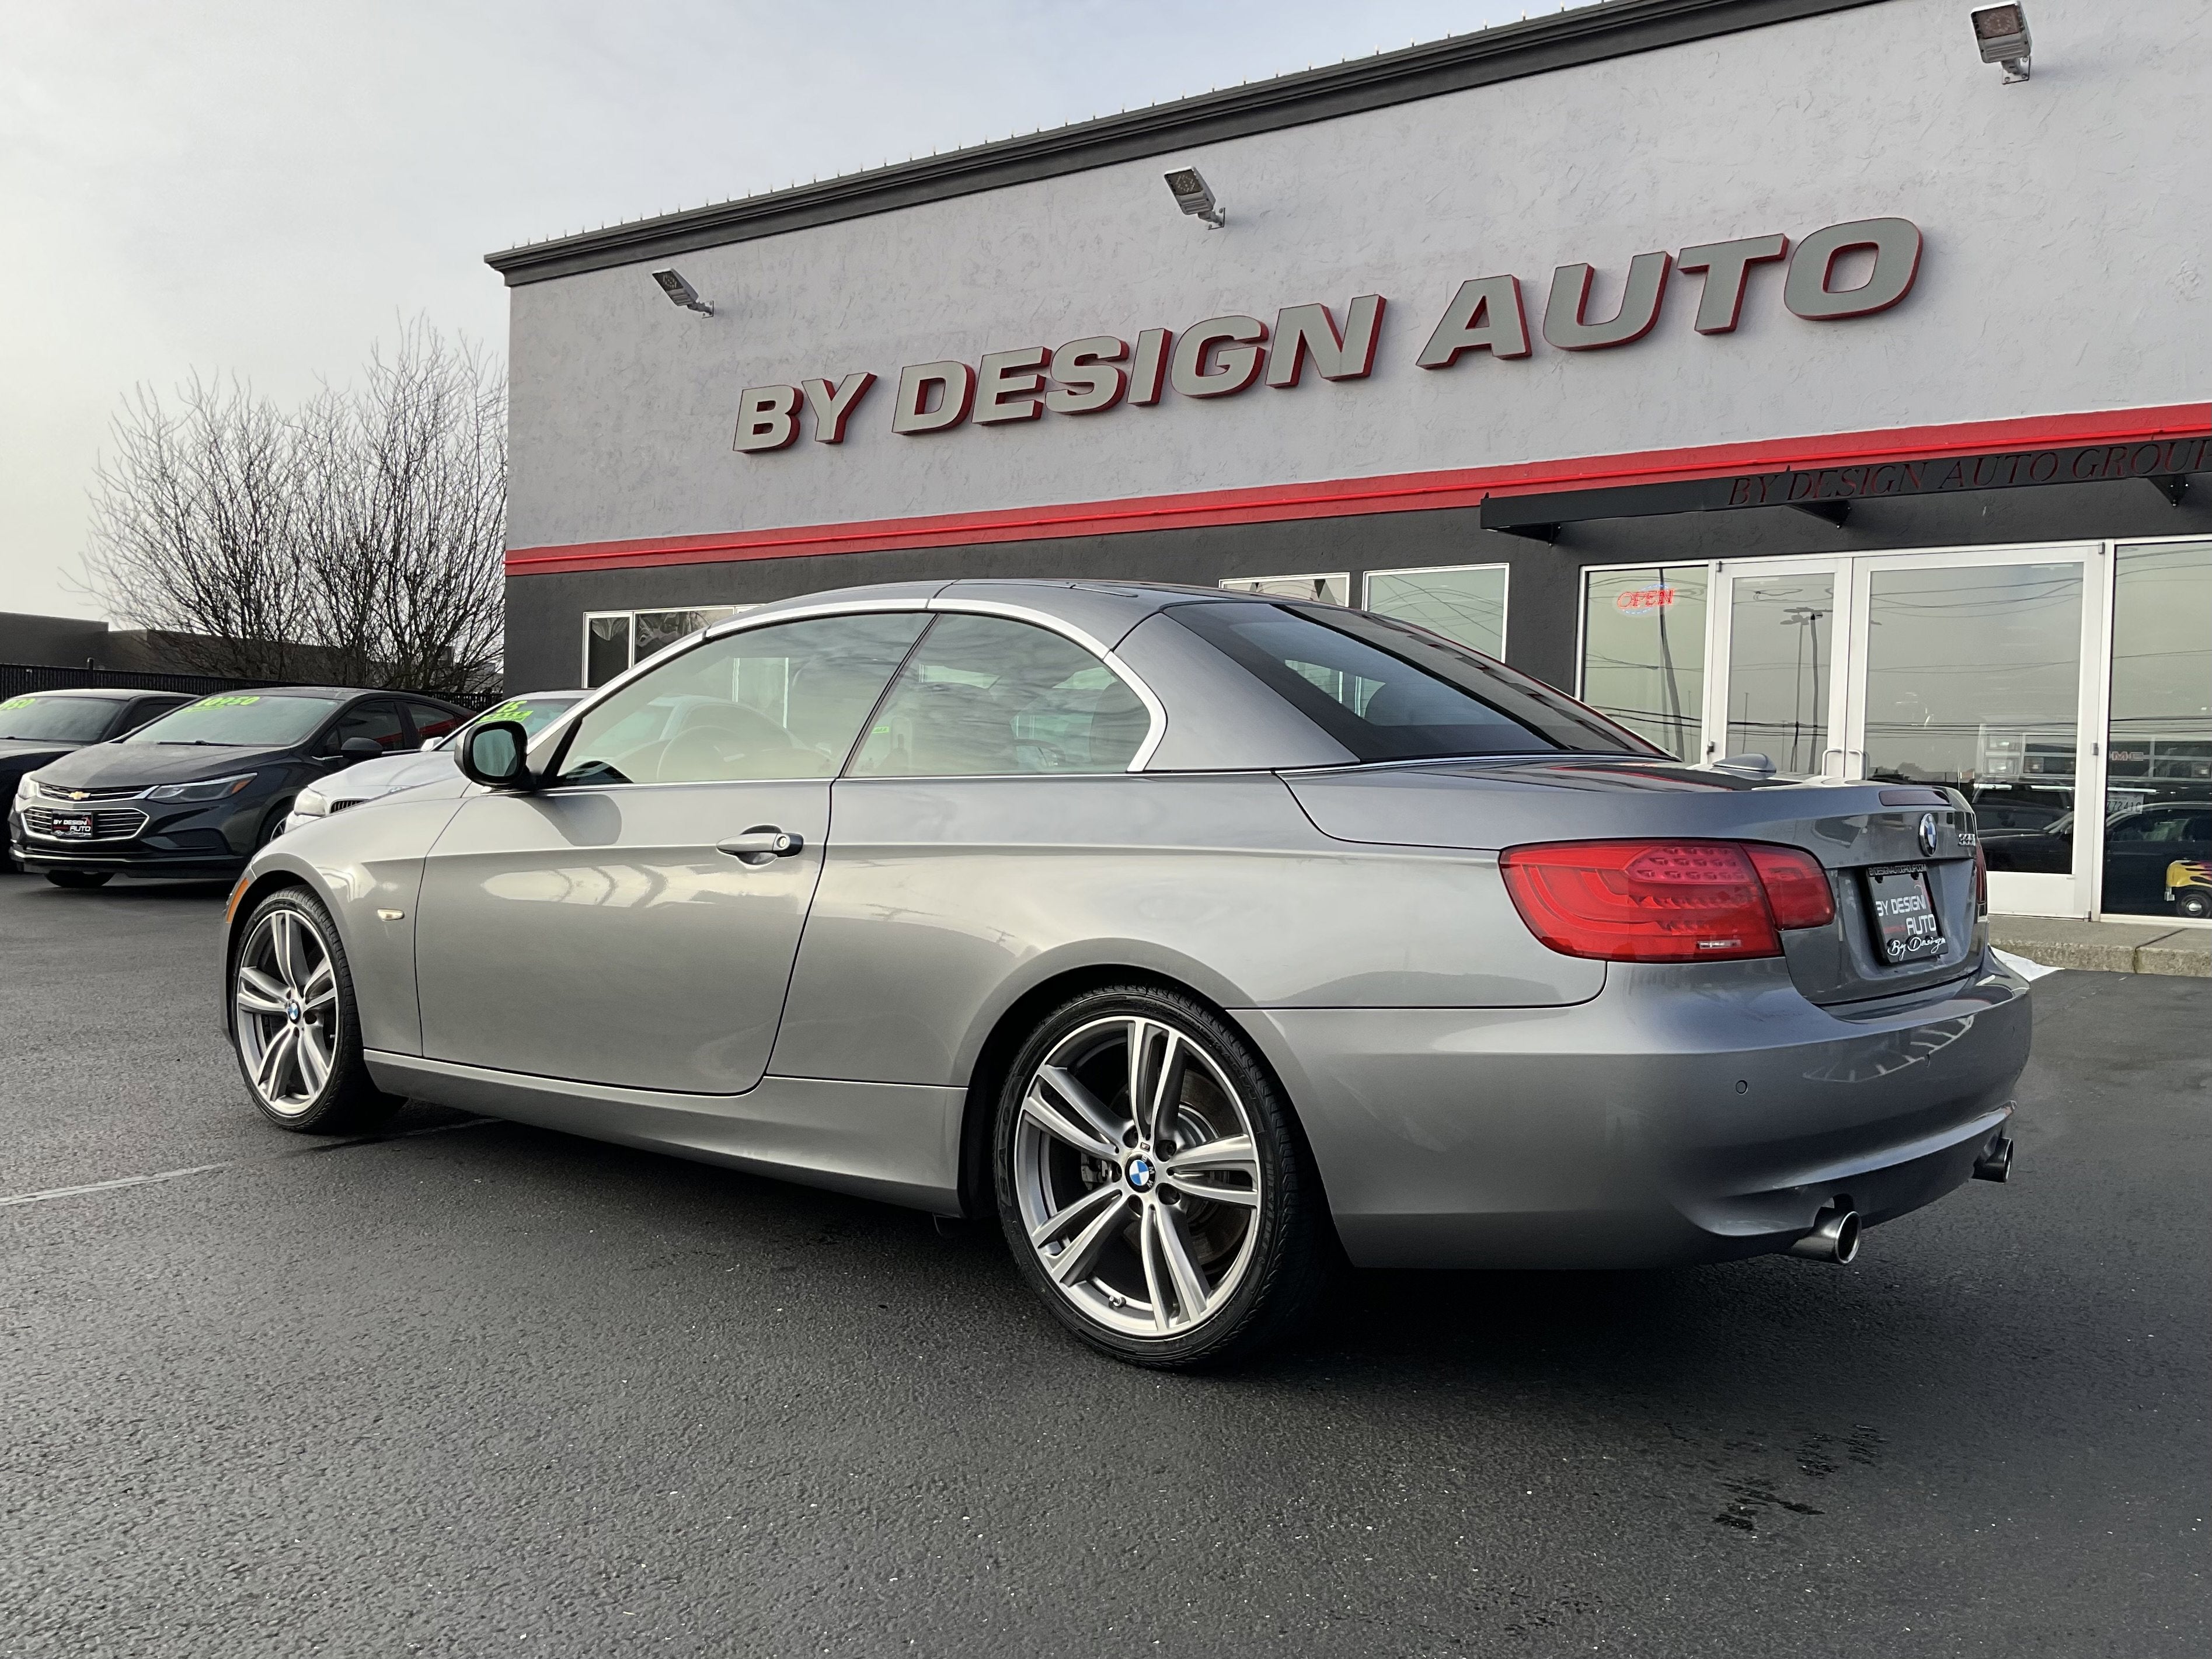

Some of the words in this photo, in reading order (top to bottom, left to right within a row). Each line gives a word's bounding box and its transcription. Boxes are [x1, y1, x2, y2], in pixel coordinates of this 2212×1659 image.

[732, 372, 877, 454] BY
[891, 294, 1386, 435] DESIGN
[1415, 217, 1922, 370] AUTO
[1727, 475, 1779, 506] BY
[1787, 462, 1928, 501] DESIGN
[1937, 452, 2060, 489] AUTO
[1617, 589, 1675, 608] OPEN
[2109, 751, 2144, 762] MC
[1875, 900, 1889, 916] BY
[1890, 894, 1927, 914] DESIGN
[1906, 914, 1936, 936] AUTO
